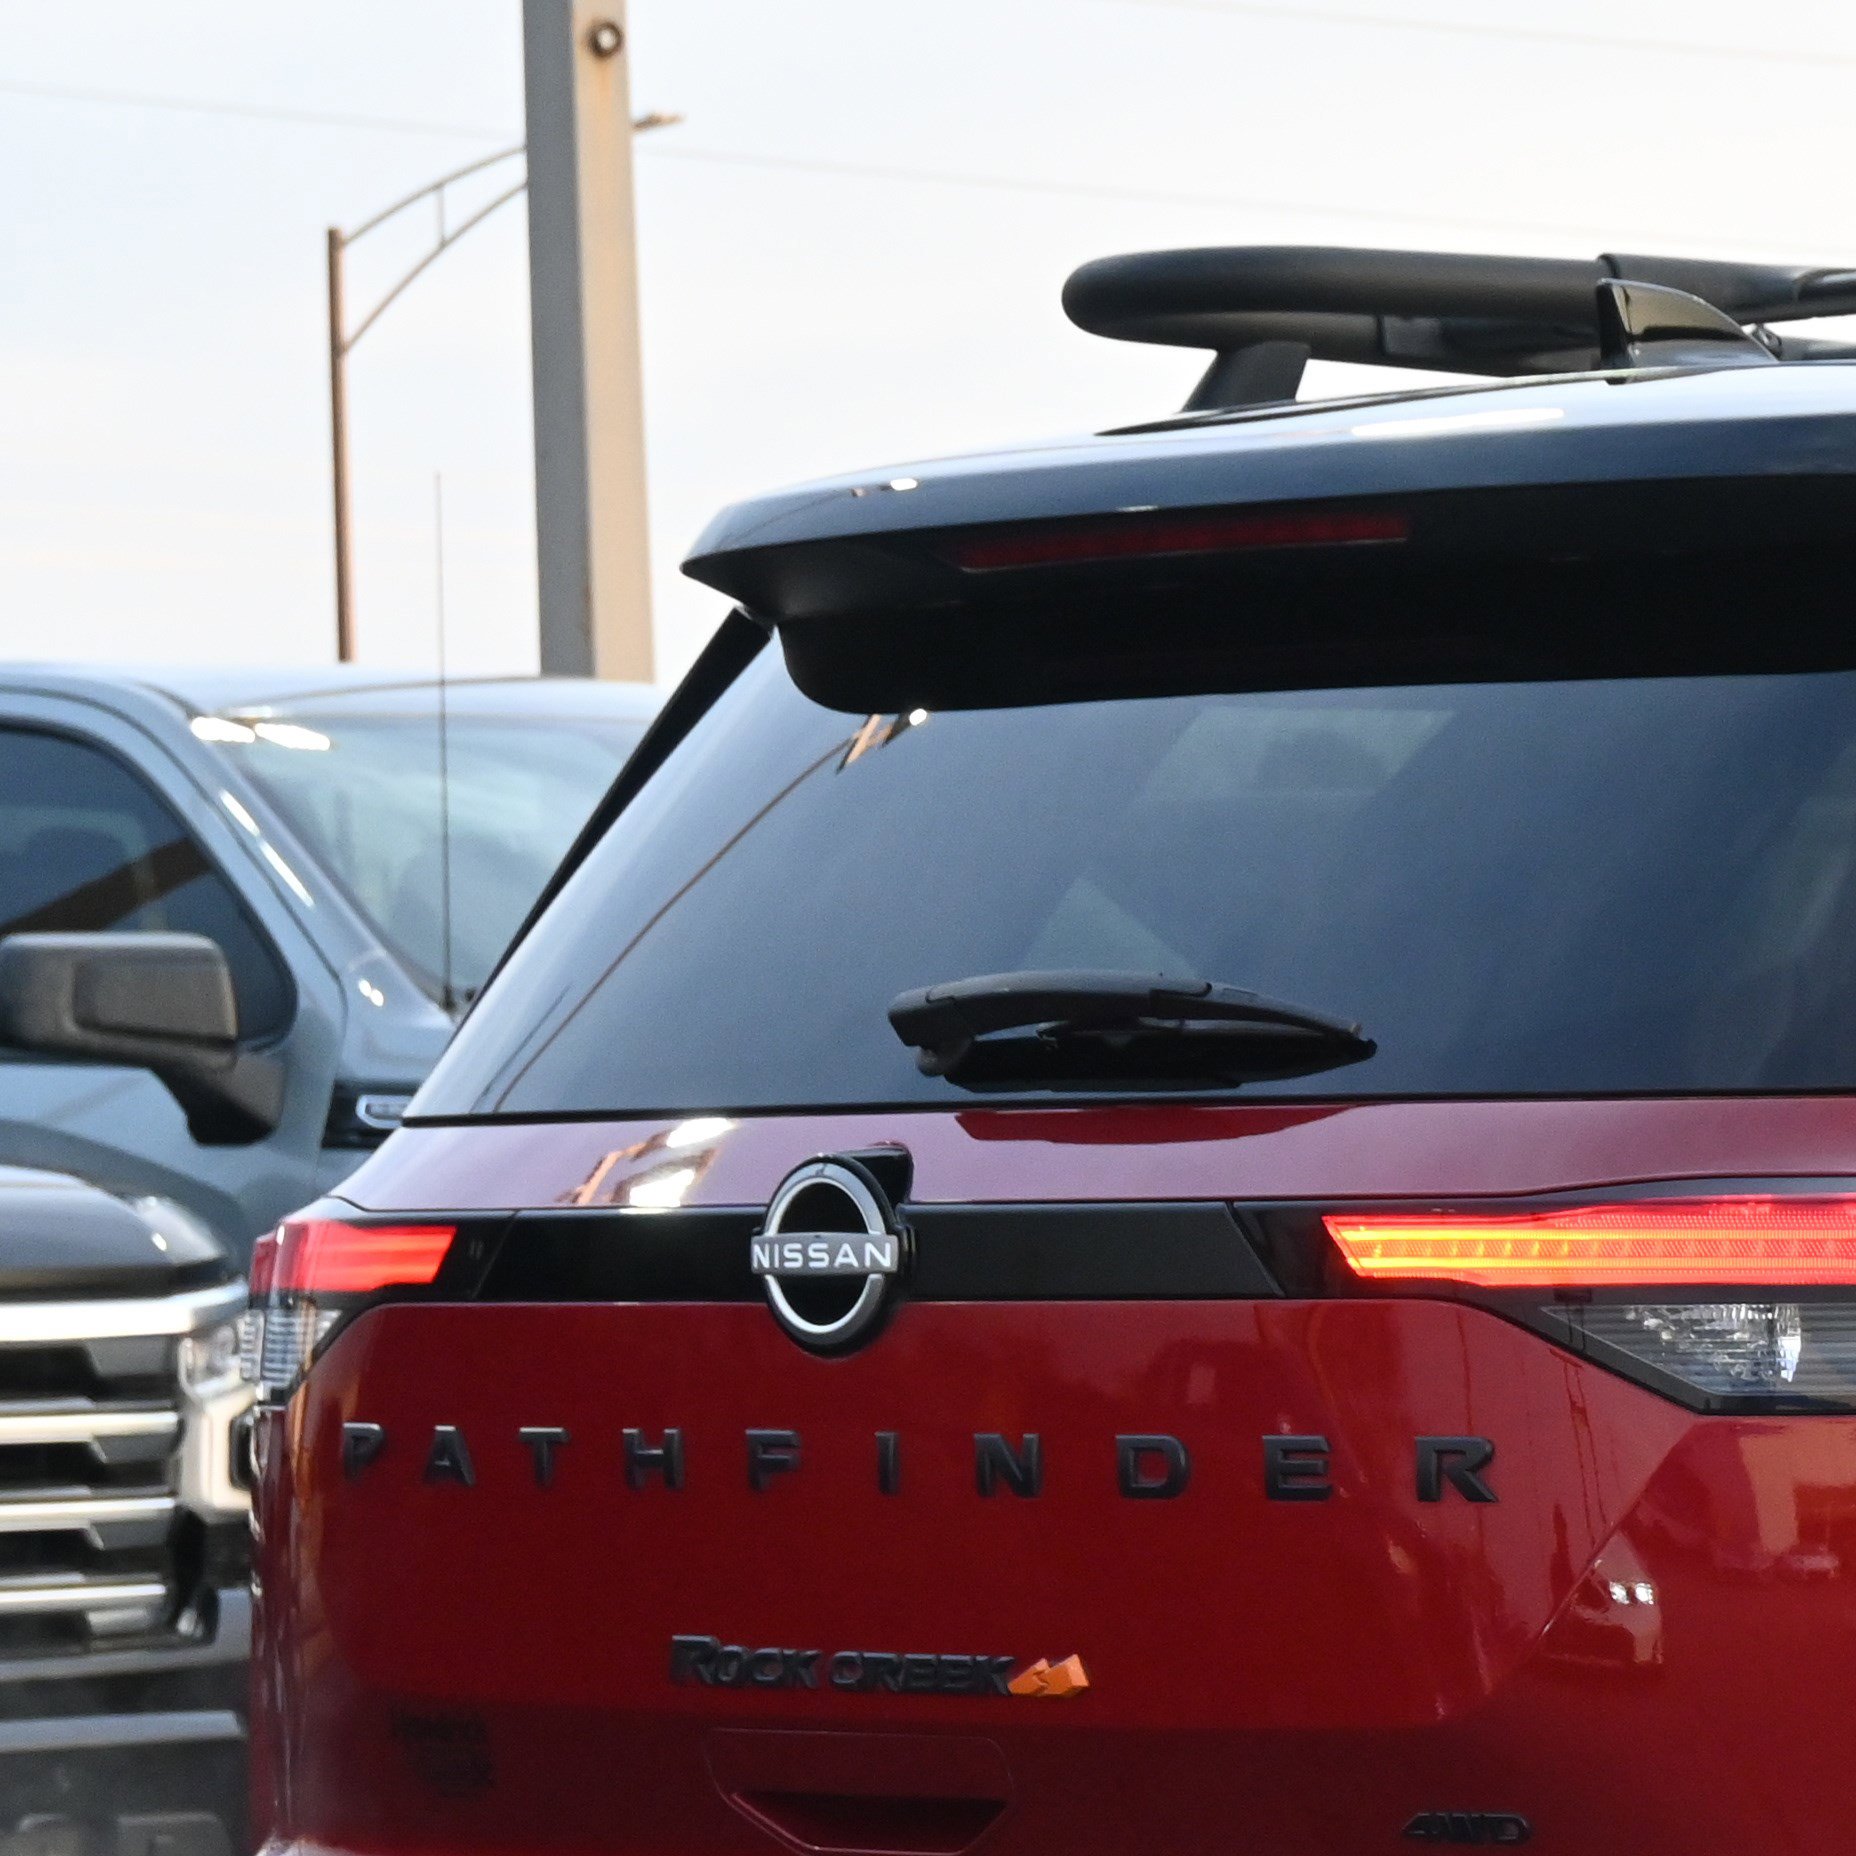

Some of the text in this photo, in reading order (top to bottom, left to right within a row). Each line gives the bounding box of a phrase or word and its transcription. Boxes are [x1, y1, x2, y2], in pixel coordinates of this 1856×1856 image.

[752, 1242, 892, 1270] NISSAN
[340, 1421, 1499, 1504] PATHFINDER
[671, 1634, 1015, 1696] ROCK CREEK
[1400, 1812, 1533, 1846] 4WD
